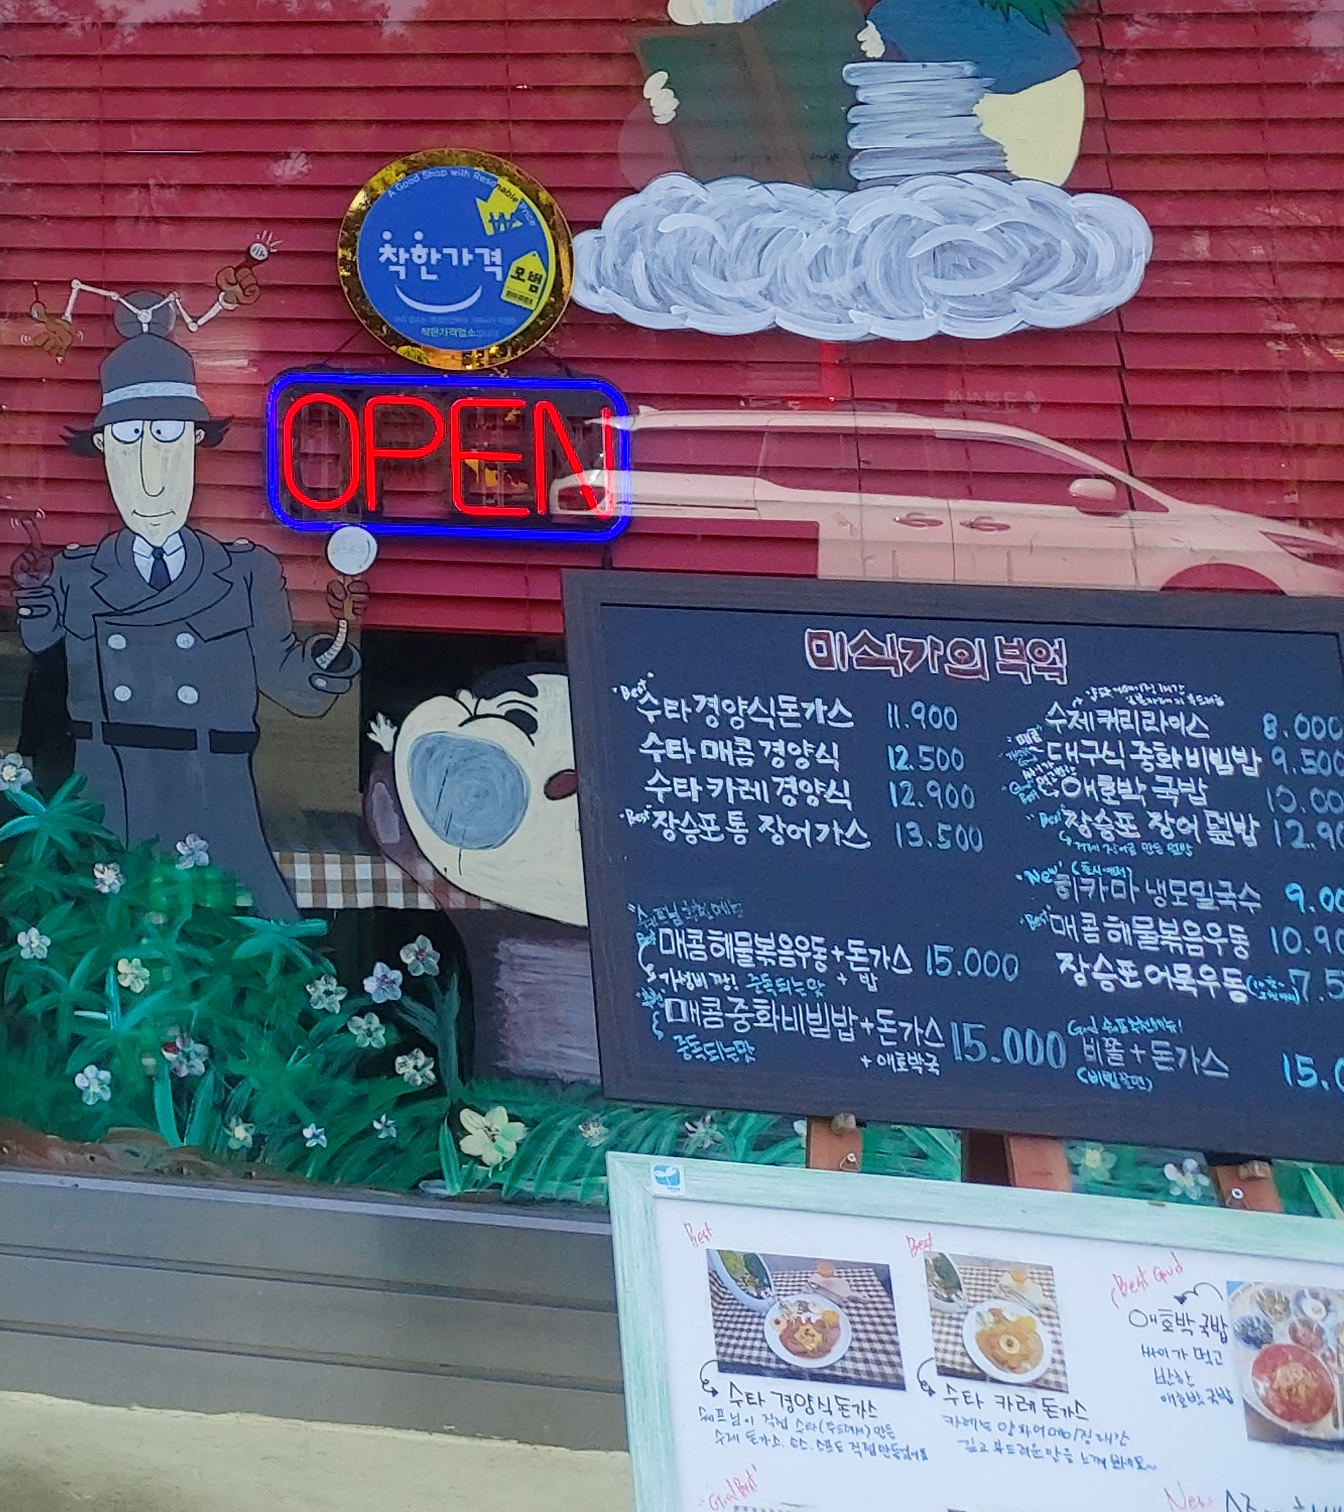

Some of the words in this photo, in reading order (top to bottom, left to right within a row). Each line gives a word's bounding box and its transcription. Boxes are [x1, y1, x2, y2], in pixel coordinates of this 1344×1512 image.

[395, 175, 421, 191] Good
[422, 169, 447, 180] Shop
[450, 168, 470, 178] with
[378, 230, 504, 282] 착한가격
[510, 266, 543, 293] 모범
[282, 392, 613, 520] OPEN
[805, 628, 990, 682] 미식가의
[994, 635, 1068, 685] 부엌
[887, 700, 958, 731] 11.900
[1263, 712, 1344, 741] 8.000
[639, 731, 696, 765] 수타
[701, 736, 755, 767] 매콤
[758, 738, 840, 773] 경양식
[887, 744, 965, 771] 12.500
[1046, 739, 1126, 771] 대구식
[1271, 746, 1344, 777] 9.500
[644, 769, 703, 804] 수타
[706, 776, 769, 804] 카레
[771, 775, 852, 812] 경양식
[889, 780, 975, 809] 12.900
[1151, 775, 1210, 808] 국밥
[895, 820, 984, 852] 13.500
[1063, 808, 1141, 842] 장승포
[1146, 810, 1202, 844] 장어
[1203, 809, 1261, 847] 덮밥
[1145, 878, 1262, 914] 냉모밀국수
[926, 943, 1019, 982] 15.000
[658, 967, 709, 992] 가성비
[859, 972, 878, 992] 밥
[950, 1020, 1067, 1070] 15.000
[1198, 1313, 1229, 1344] 국밥
[1194, 1346, 1223, 1365] 먹고
[729, 1381, 765, 1408] 수타
[943, 1383, 984, 1410] 수타
[714, 1428, 741, 1448] 수제
[762, 1412, 788, 1430] 직접
[873, 1422, 896, 1439] 만든
